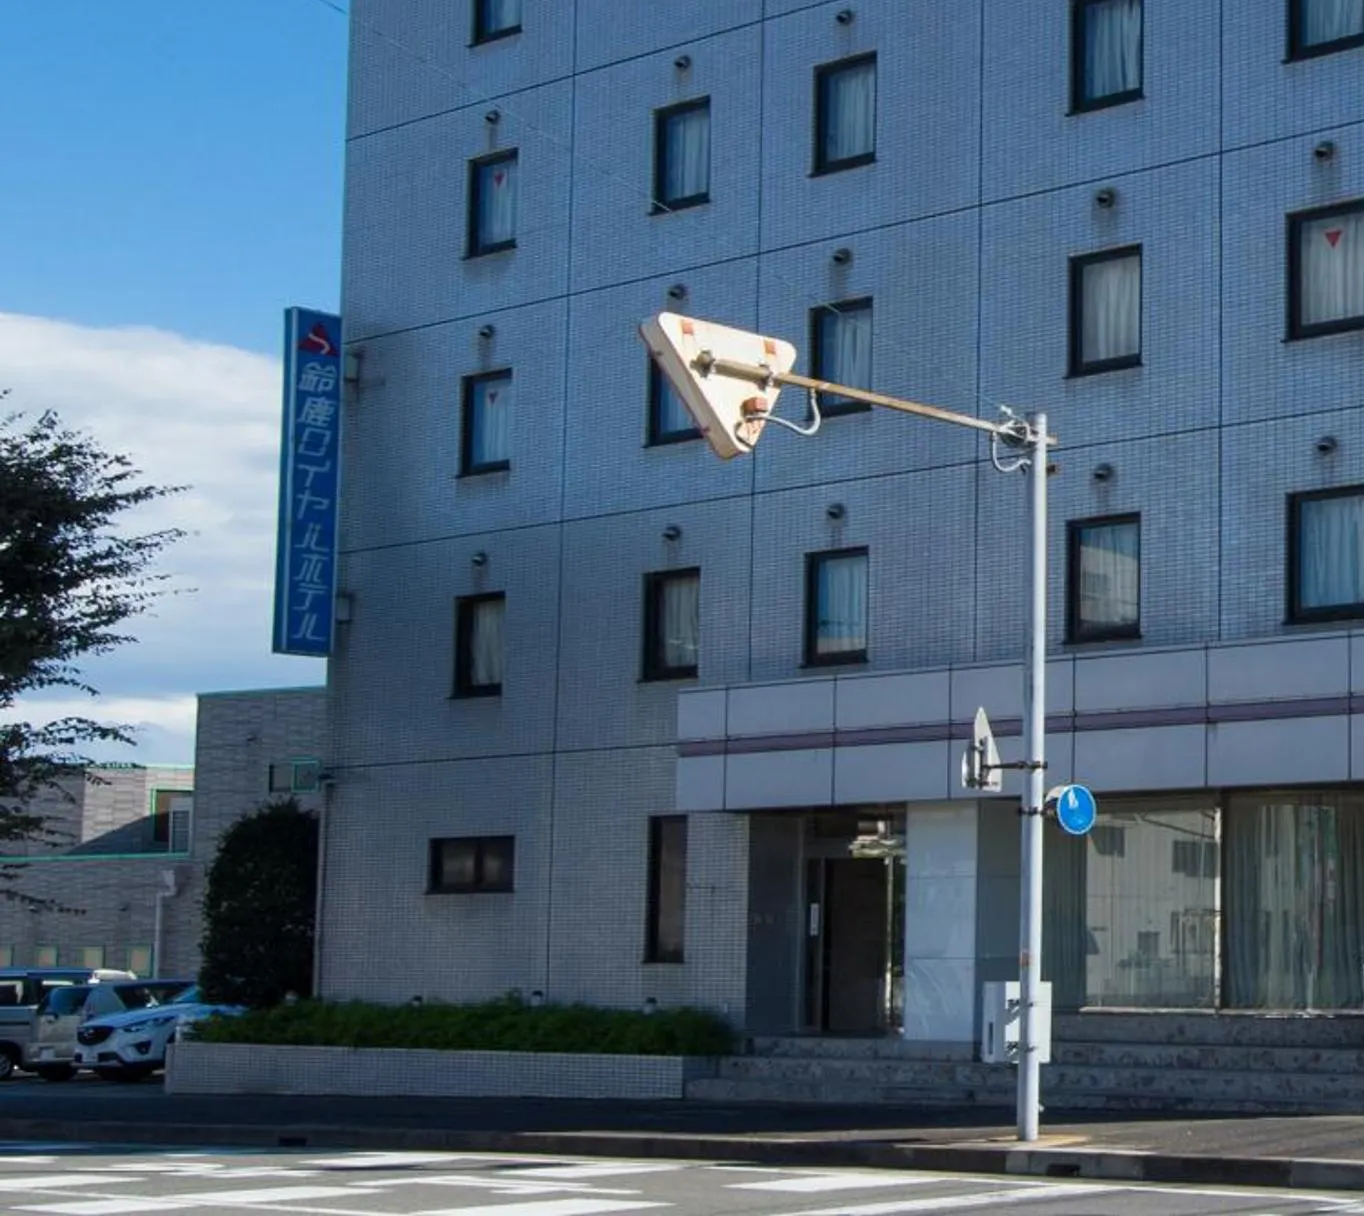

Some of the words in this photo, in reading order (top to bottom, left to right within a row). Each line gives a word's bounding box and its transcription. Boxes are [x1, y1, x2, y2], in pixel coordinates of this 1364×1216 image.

[293, 361, 337, 641] 鈴鹿ロイヤルホテル
